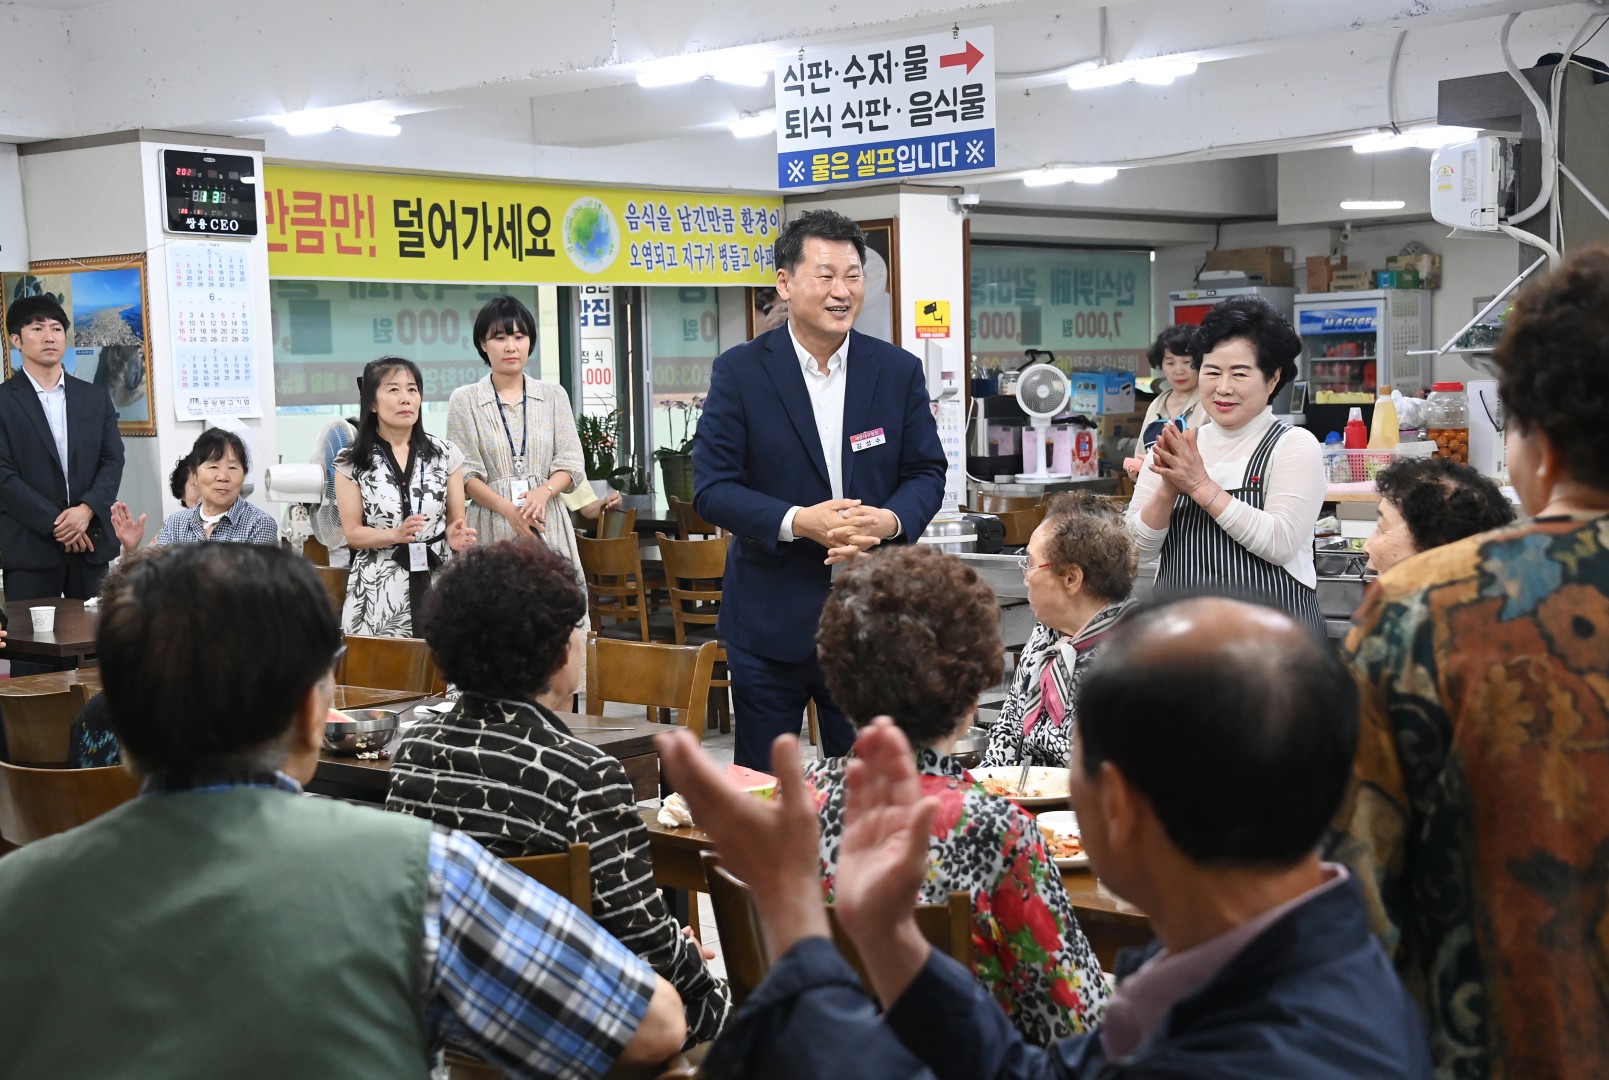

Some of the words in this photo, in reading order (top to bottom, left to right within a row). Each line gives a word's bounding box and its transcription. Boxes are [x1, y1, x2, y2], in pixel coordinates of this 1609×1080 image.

[785, 104, 832, 139] 퇴식
[811, 152, 849, 182] 물은
[856, 140, 958, 177] 셀프입니다
[210, 219, 238, 231] CEO
[393, 198, 555, 262] 덜어가세요
[624, 203, 672, 232] 음식을
[677, 206, 735, 234] 남긴만큼
[740, 208, 781, 235] 환경이
[630, 242, 678, 271] 오염되고
[682, 243, 715, 272] 지구가
[719, 243, 750, 272] 병들고
